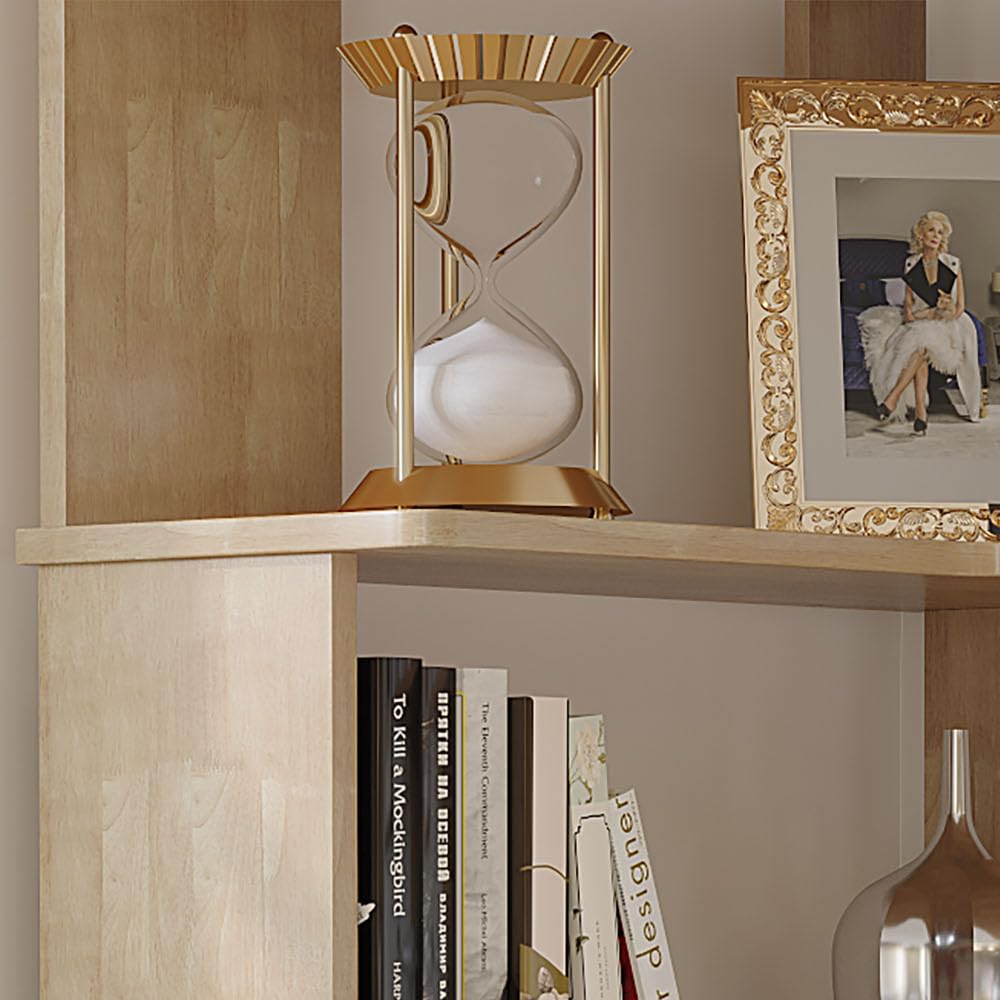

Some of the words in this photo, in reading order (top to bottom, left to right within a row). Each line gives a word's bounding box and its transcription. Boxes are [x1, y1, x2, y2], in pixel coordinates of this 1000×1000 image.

[393, 693, 406, 720] To
[437, 692, 449, 766] ПРЯТКИ
[481, 703, 490, 723] The
[393, 727, 406, 757] Kill
[393, 764, 404, 777] a
[480, 727, 489, 773] Eleventh
[480, 776, 489, 860] Commandment
[389, 784, 406, 917] Mockingbird
[615, 793, 663, 968] designer
[438, 893, 447, 974] ВЛАДИМИР
